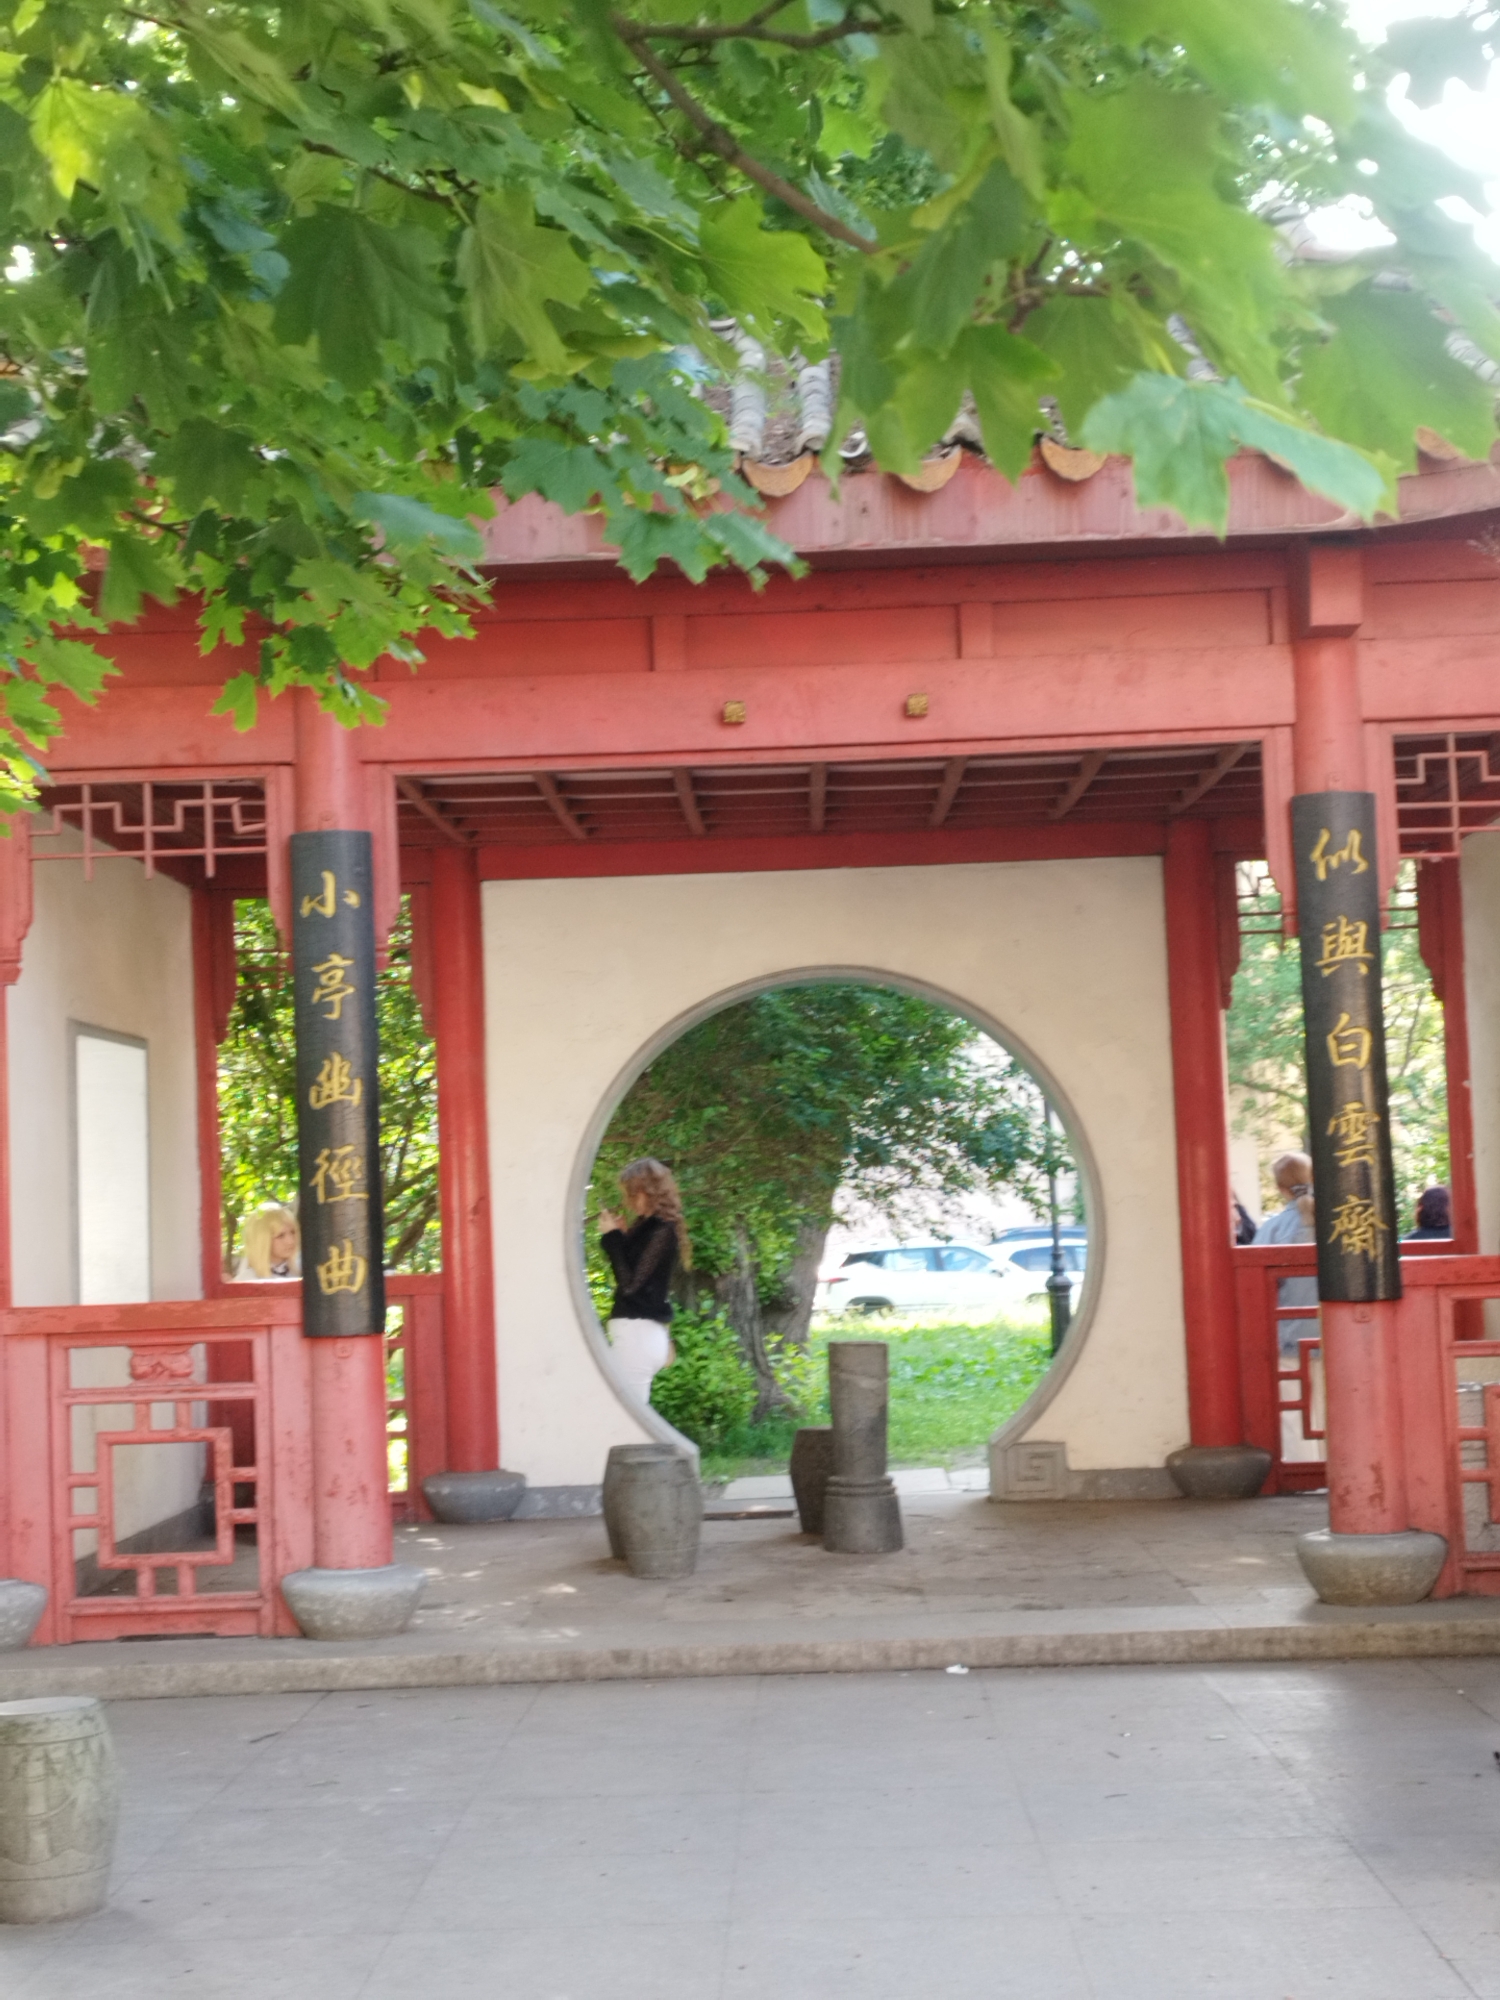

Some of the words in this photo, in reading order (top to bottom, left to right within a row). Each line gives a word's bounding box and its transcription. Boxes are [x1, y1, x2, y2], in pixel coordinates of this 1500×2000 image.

[300, 869, 369, 1295] 小亭幽徑曲
